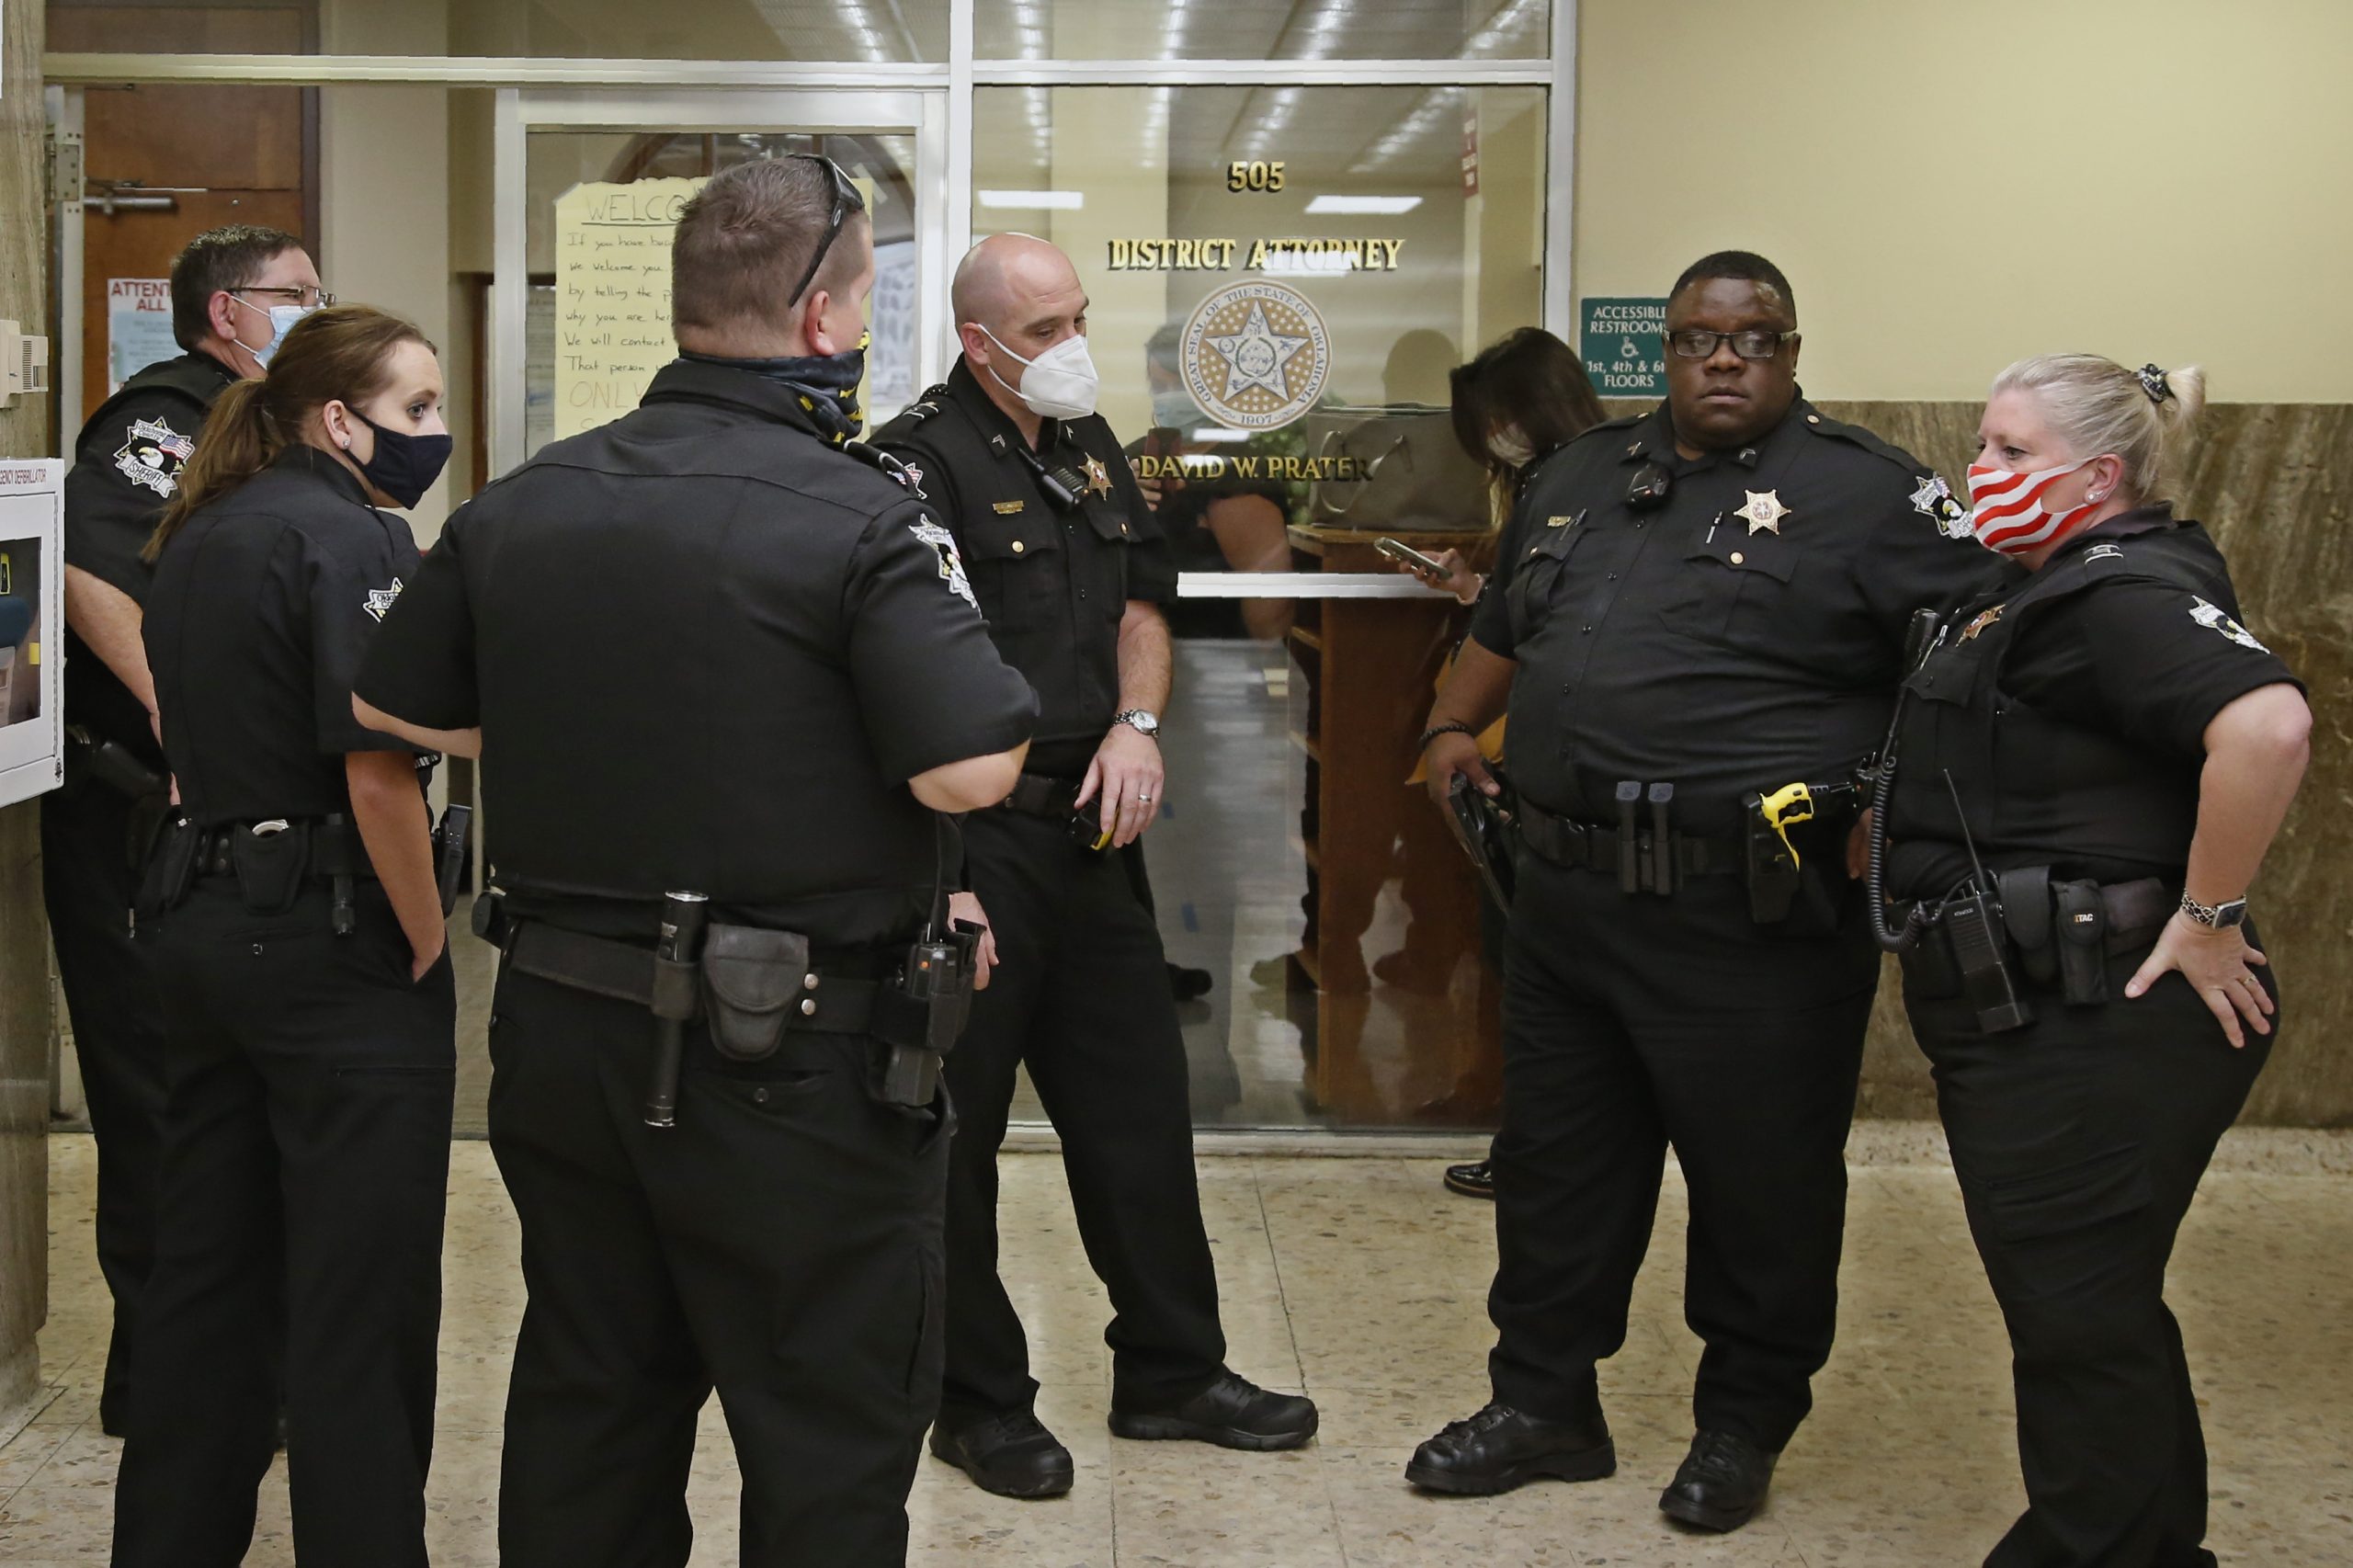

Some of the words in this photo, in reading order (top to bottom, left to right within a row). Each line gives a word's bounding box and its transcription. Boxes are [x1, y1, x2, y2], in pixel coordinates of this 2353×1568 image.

[1229, 161, 1286, 191] 505
[567, 233, 585, 245] If
[596, 241, 613, 251] you
[618, 235, 644, 246] have
[1108, 238, 1235, 270] DISTRICT
[1245, 238, 1405, 270] ATTORNEY
[569, 282, 584, 302] by
[595, 285, 628, 301] telling
[636, 286, 653, 297] the
[1225, 288, 1252, 302] THE
[1254, 287, 1294, 306] STATE
[136, 299, 166, 312] ALL
[1205, 301, 1221, 317] OF
[1295, 302, 1312, 318] OF
[566, 309, 585, 326] why
[597, 314, 617, 326] you
[626, 313, 646, 322] are
[564, 332, 581, 346] We
[591, 334, 610, 345] will
[620, 335, 665, 346] contact
[1188, 321, 1208, 355] SEAL
[563, 355, 598, 370] That
[609, 364, 645, 375] person
[1298, 325, 1325, 404] OKLAHOMA
[1586, 360, 1607, 373] 1st,
[1611, 360, 1632, 372] 4th
[1638, 360, 1648, 372] &
[1188, 360, 1212, 403] GREAT
[1604, 374, 1654, 387] FLOORS
[1241, 415, 1273, 425] 1907
[130, 462, 164, 484] SHERIFF
[1140, 455, 1225, 479] DAVID
[1232, 456, 1259, 479] W.
[1267, 457, 1374, 482] PRATER
